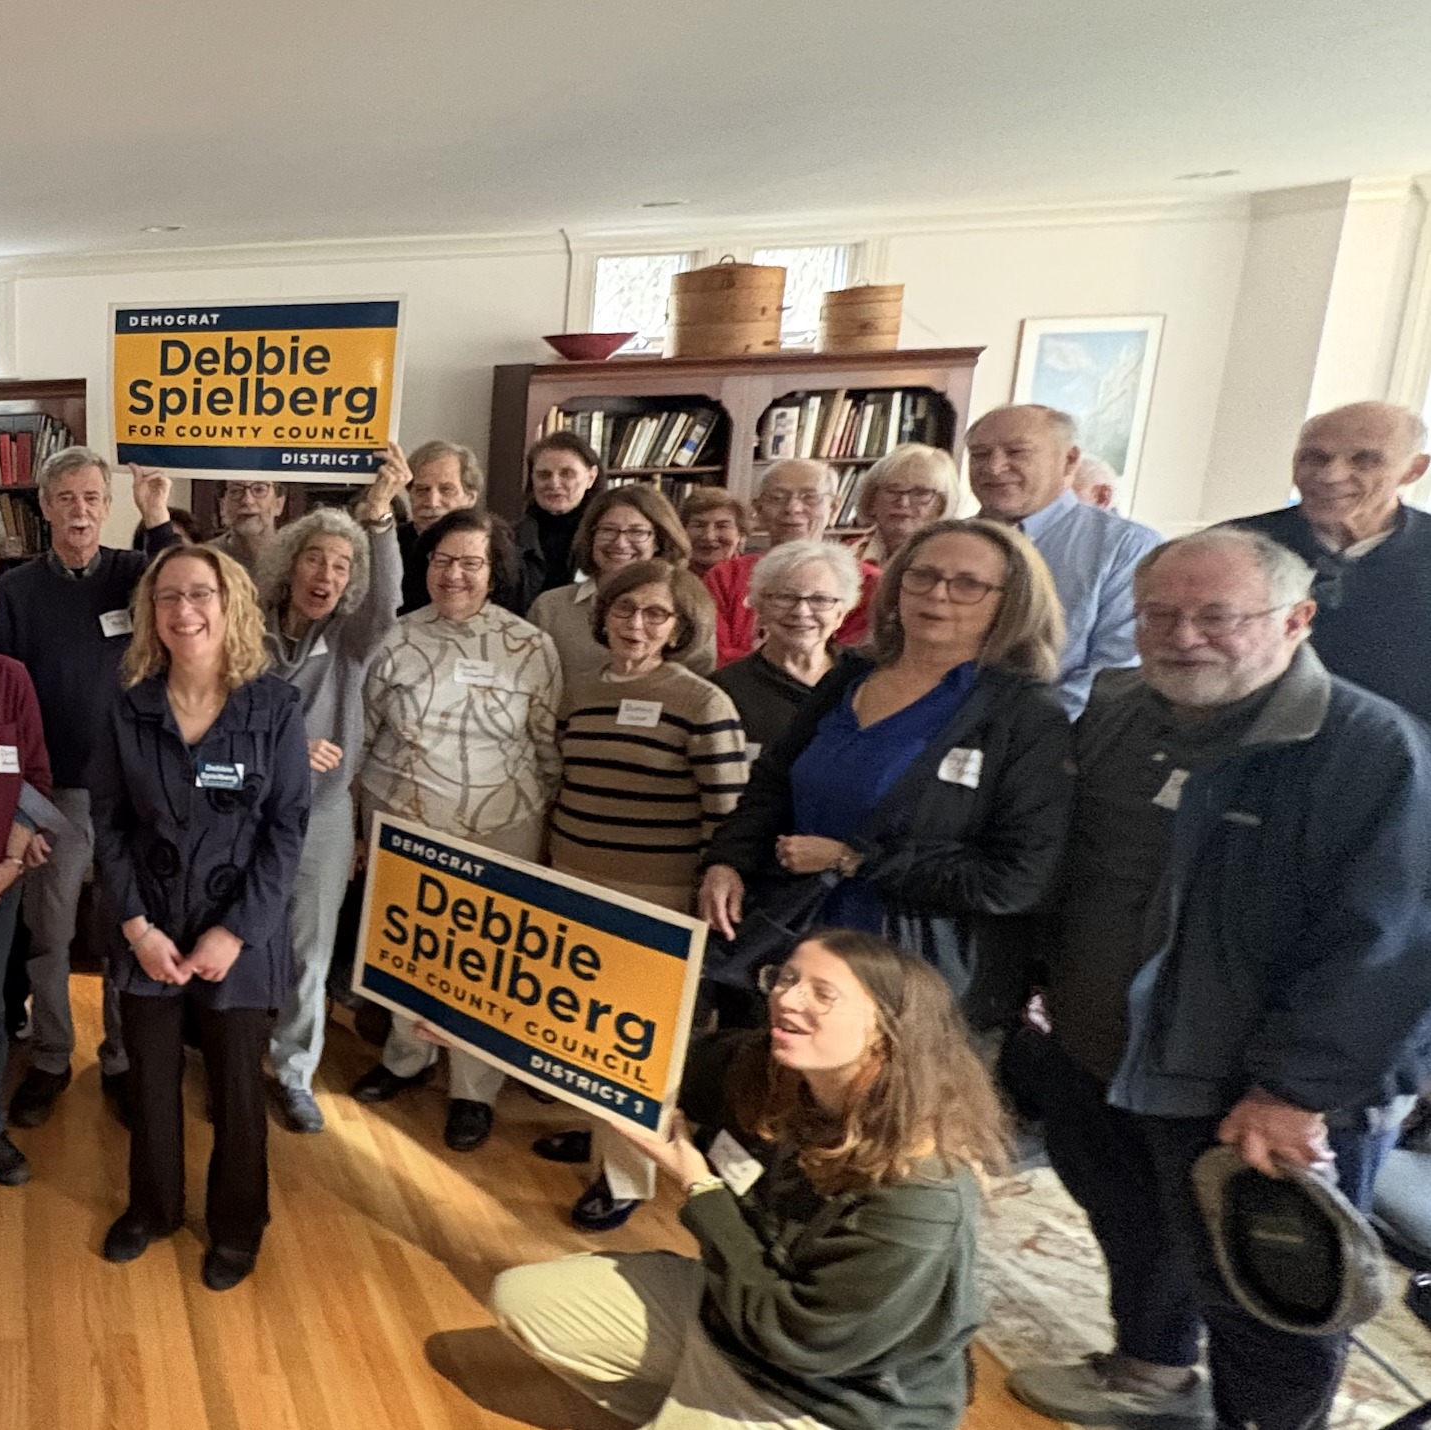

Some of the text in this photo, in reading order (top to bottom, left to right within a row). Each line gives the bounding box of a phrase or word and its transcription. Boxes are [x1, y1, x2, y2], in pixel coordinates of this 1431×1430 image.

[128, 313, 221, 328] DEMOCRAT
[159, 335, 331, 376] Debbie
[128, 377, 378, 425] Spielberg
[128, 425, 375, 440] FOR COUNTY COUNCIL
[281, 452, 373, 467] DISTRICT 1
[390, 833, 486, 878] DEMOCRAT
[415, 872, 601, 981] Debbie
[382, 903, 657, 1062] Spielberg
[378, 949, 419, 977] FOR
[426, 972, 517, 1026] COUNTY
[524, 1020, 649, 1084] COUNCIL
[529, 1054, 629, 1107] DISTRICT
[633, 1099, 645, 1116] 1
